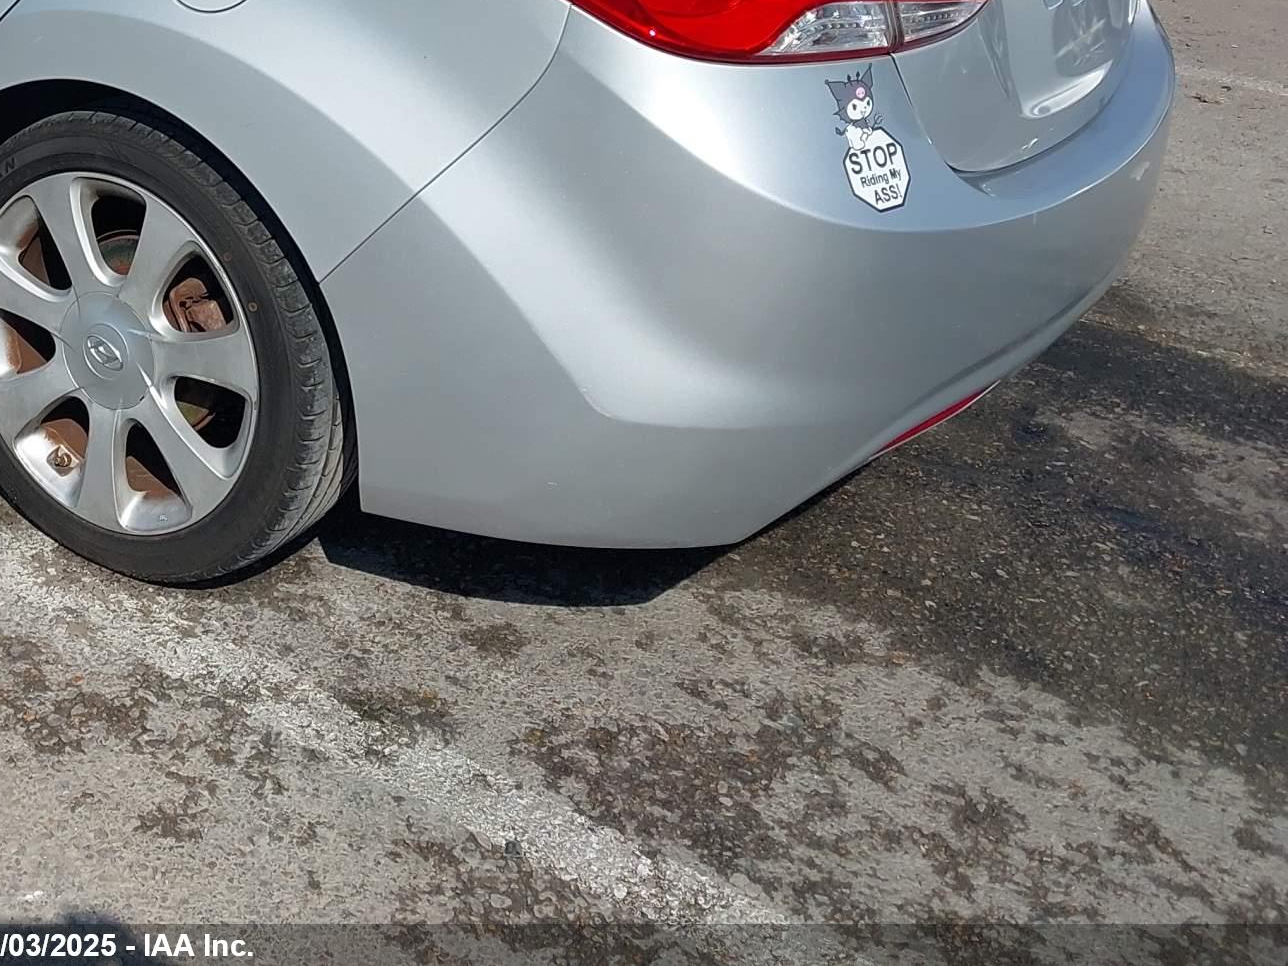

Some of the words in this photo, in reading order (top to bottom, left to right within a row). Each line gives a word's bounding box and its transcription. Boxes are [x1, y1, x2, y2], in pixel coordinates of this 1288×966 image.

[848, 142, 898, 175] STOP
[860, 173, 890, 188] Riding
[889, 168, 902, 182] My
[874, 183, 903, 205] ASS!
